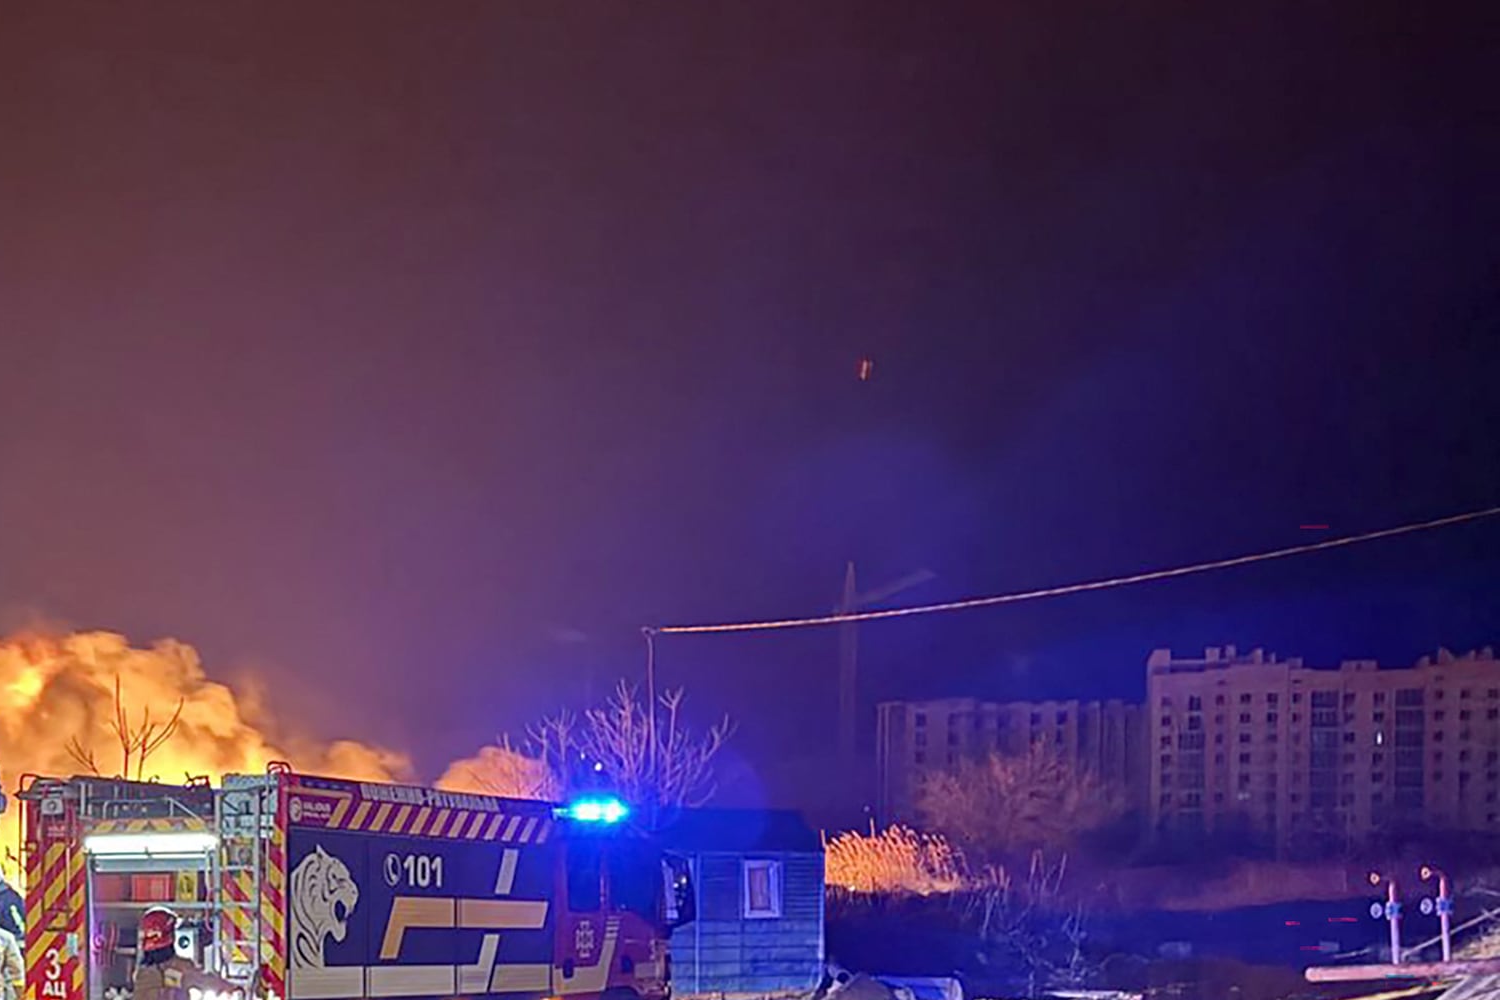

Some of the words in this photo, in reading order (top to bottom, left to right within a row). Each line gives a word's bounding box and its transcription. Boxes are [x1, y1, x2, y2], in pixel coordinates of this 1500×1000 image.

[403, 854, 442, 888] 101
[45, 949, 61, 980] 3
[42, 981, 67, 999] АЦ
